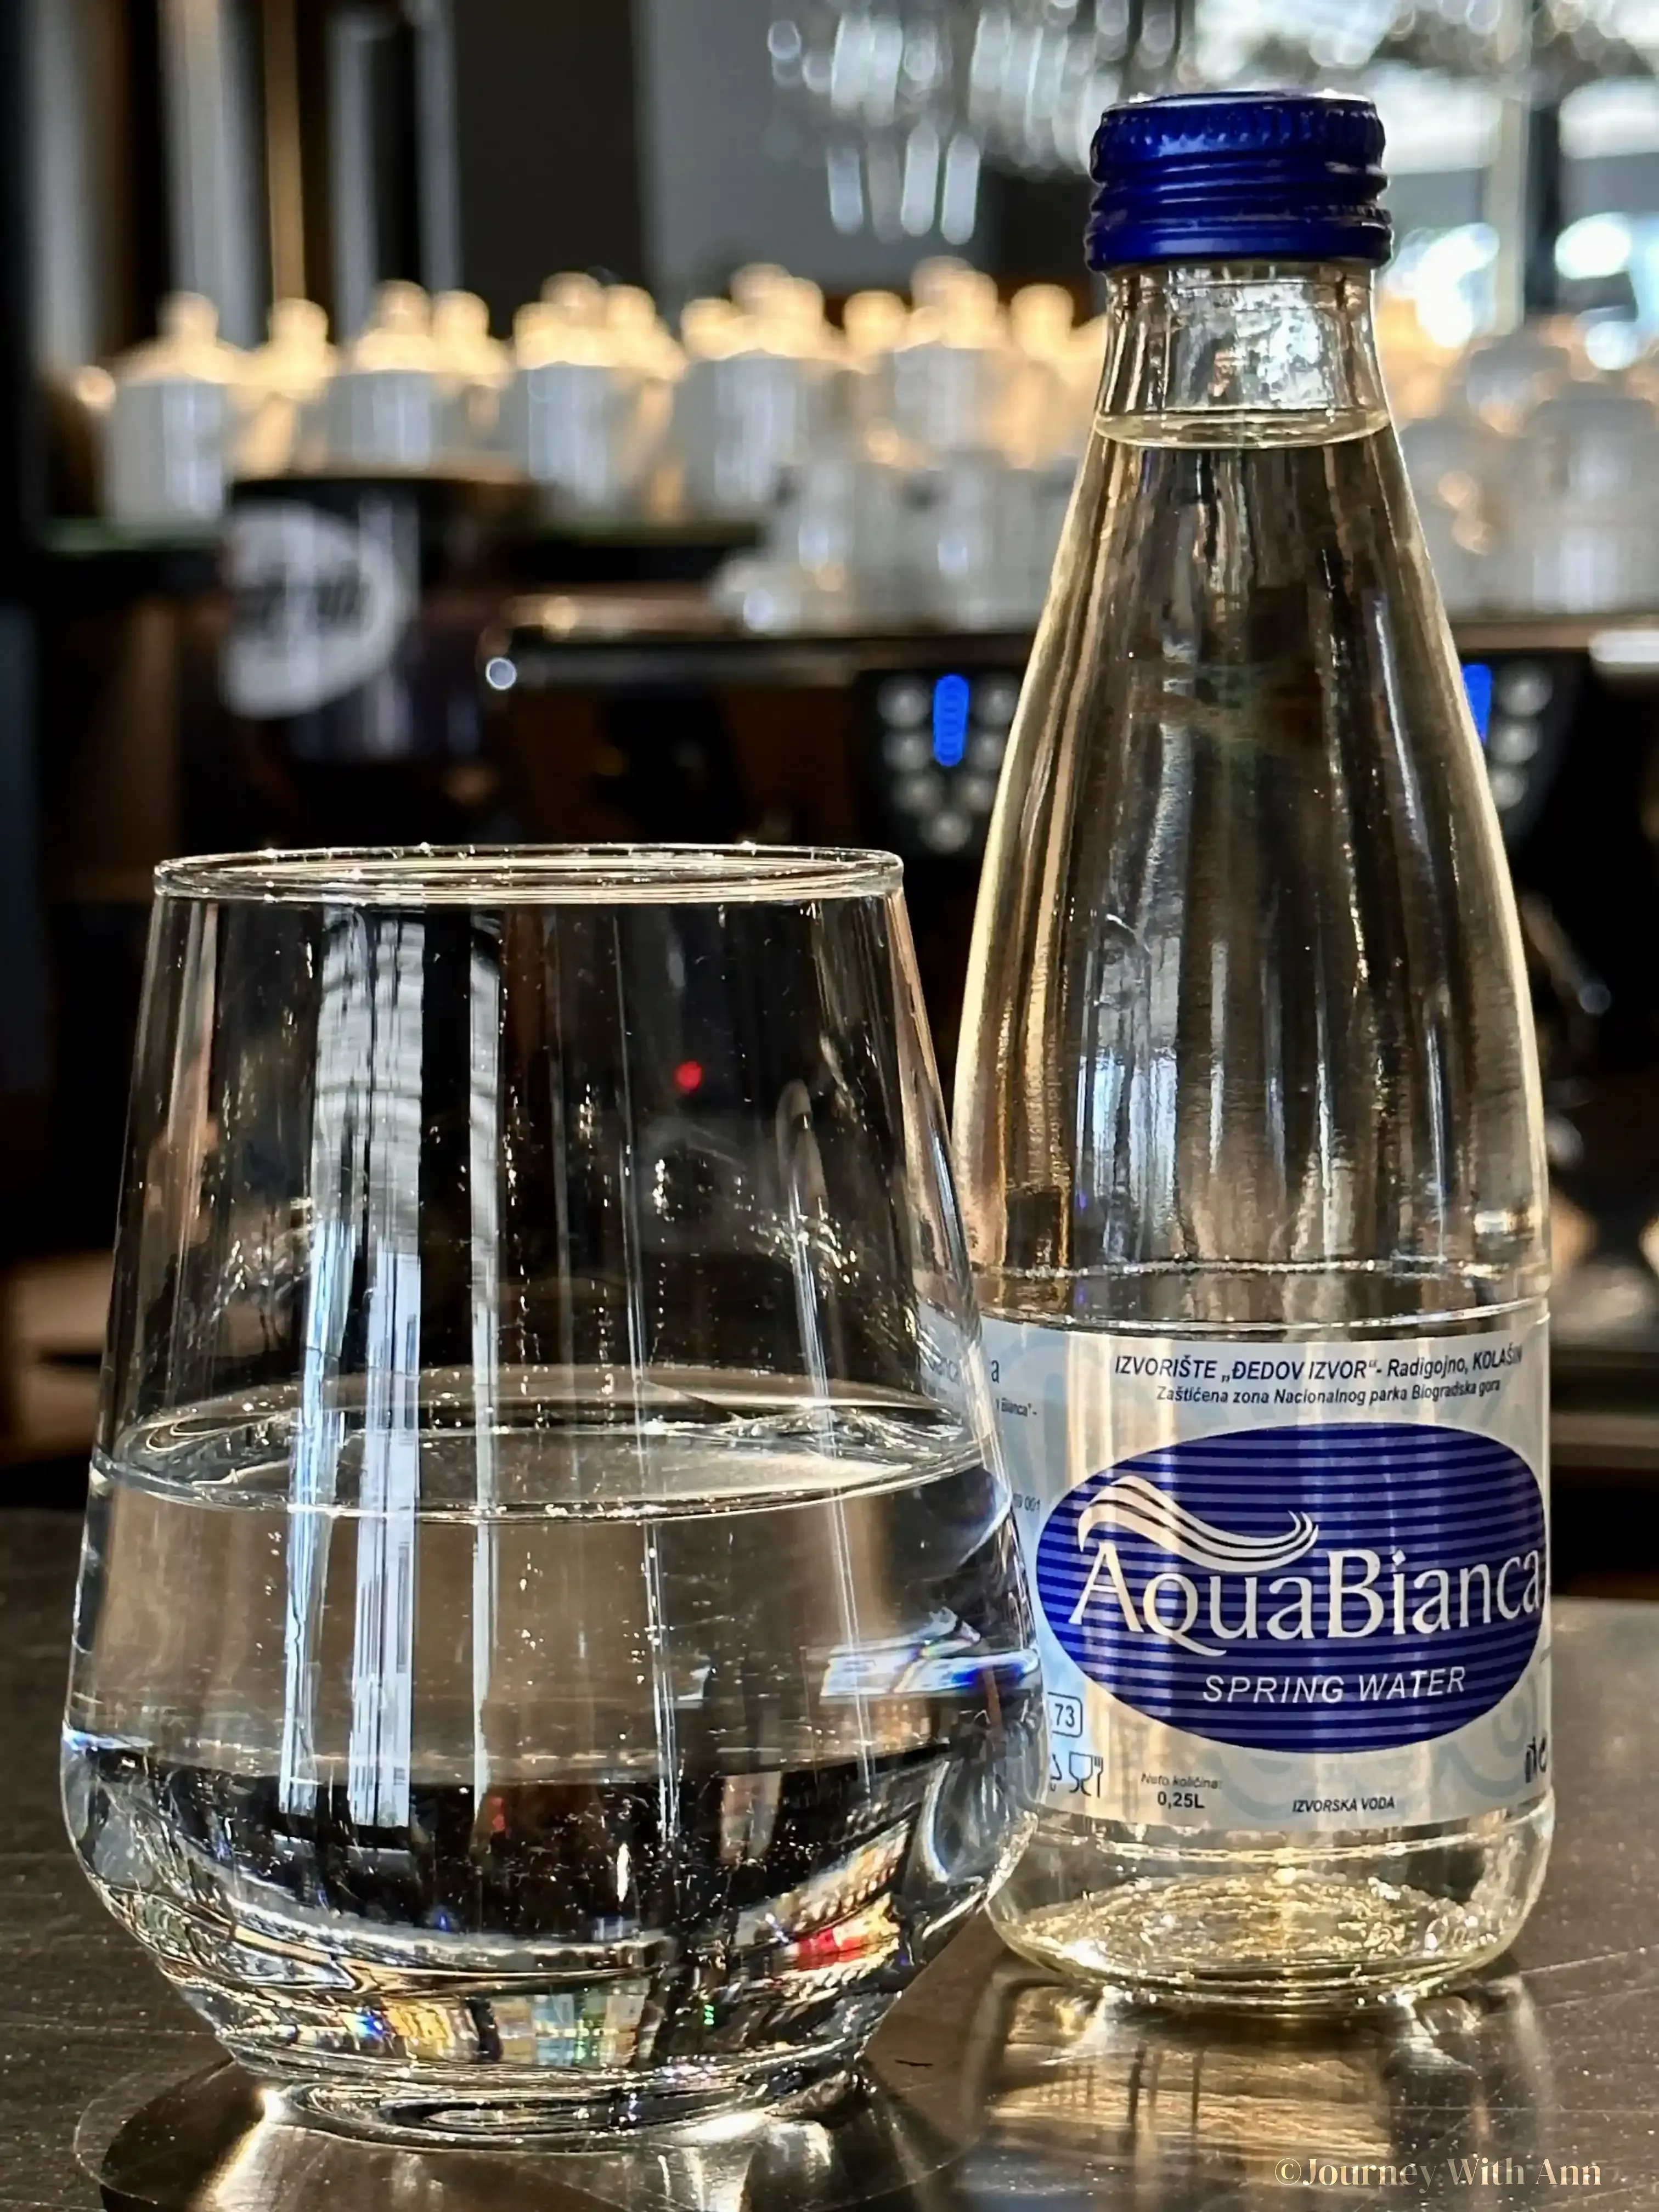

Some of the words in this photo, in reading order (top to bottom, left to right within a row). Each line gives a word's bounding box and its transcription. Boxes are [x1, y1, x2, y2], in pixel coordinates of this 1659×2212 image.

[1114, 1355, 1217, 1379] IZVORIŠTE
[1387, 1355, 1469, 1379] Radigojno,
[1156, 1386, 1228, 1404] Zaštićena
[1233, 1391, 1269, 1404] zona
[1274, 1389, 1365, 1406] Nacionalnog
[1369, 1387, 1408, 1406] parka
[1412, 1380, 1477, 1403] Biogradska
[1479, 1379, 1501, 1397] gora
[1068, 1542, 1540, 1657] AquaBianca
[1202, 1674, 1345, 1704] SPRING
[1358, 1666, 1467, 1700] WATER
[1054, 1703, 1076, 1728] 73
[1157, 1791, 1206, 1810] 0,25L
[1292, 1798, 1358, 1813] IZVORSKA
[1361, 1796, 1395, 1811] VODA
